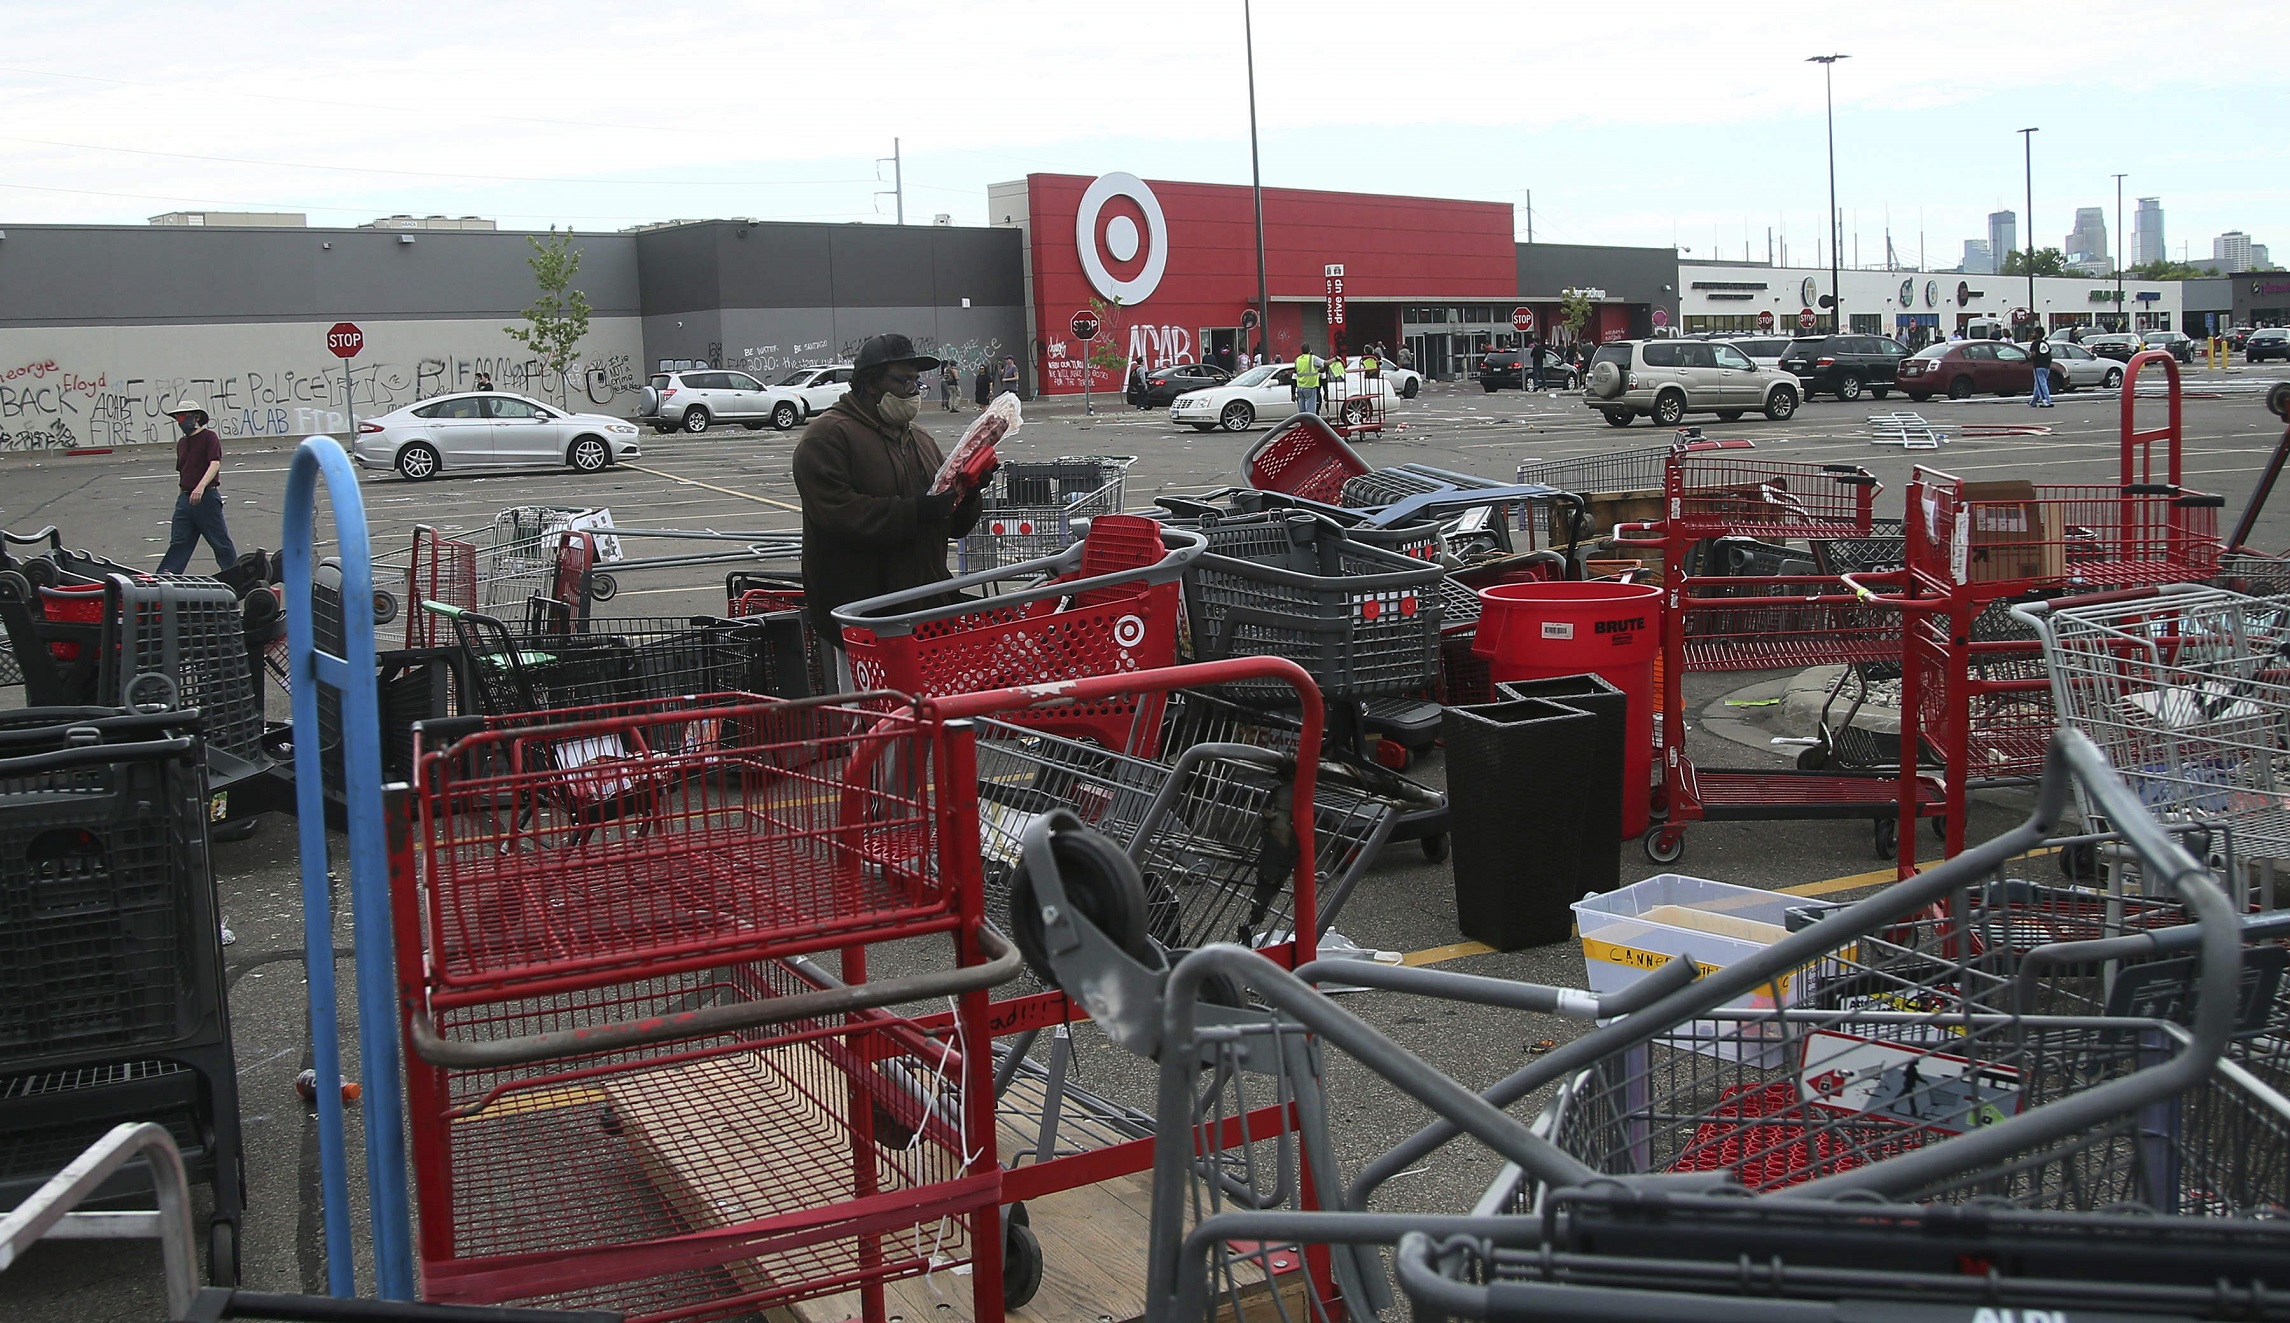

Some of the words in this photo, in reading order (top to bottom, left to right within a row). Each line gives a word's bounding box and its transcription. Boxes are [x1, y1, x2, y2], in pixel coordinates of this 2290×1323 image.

[1326, 279, 1333, 294] up
[1334, 279, 1344, 294] up
[1334, 296, 1344, 324] drive
[1513, 315, 1531, 325] STOP
[1758, 317, 1773, 325] STOP
[1801, 314, 1815, 323] STOP
[329, 333, 361, 348] STOP
[744, 348, 754, 356] BE
[793, 344, 802, 354] BE
[1122, 325, 1195, 393] ACAB
[609, 366, 624, 379] NOT
[63, 372, 107, 398] Floyd
[0, 384, 78, 417] BACK
[190, 377, 241, 415] THE
[91, 393, 132, 421] ACAB
[239, 408, 290, 436] ACAB
[90, 417, 136, 445] FIRE
[207, 416, 240, 439] PIGS
[1594, 616, 1646, 634] BRUTE
